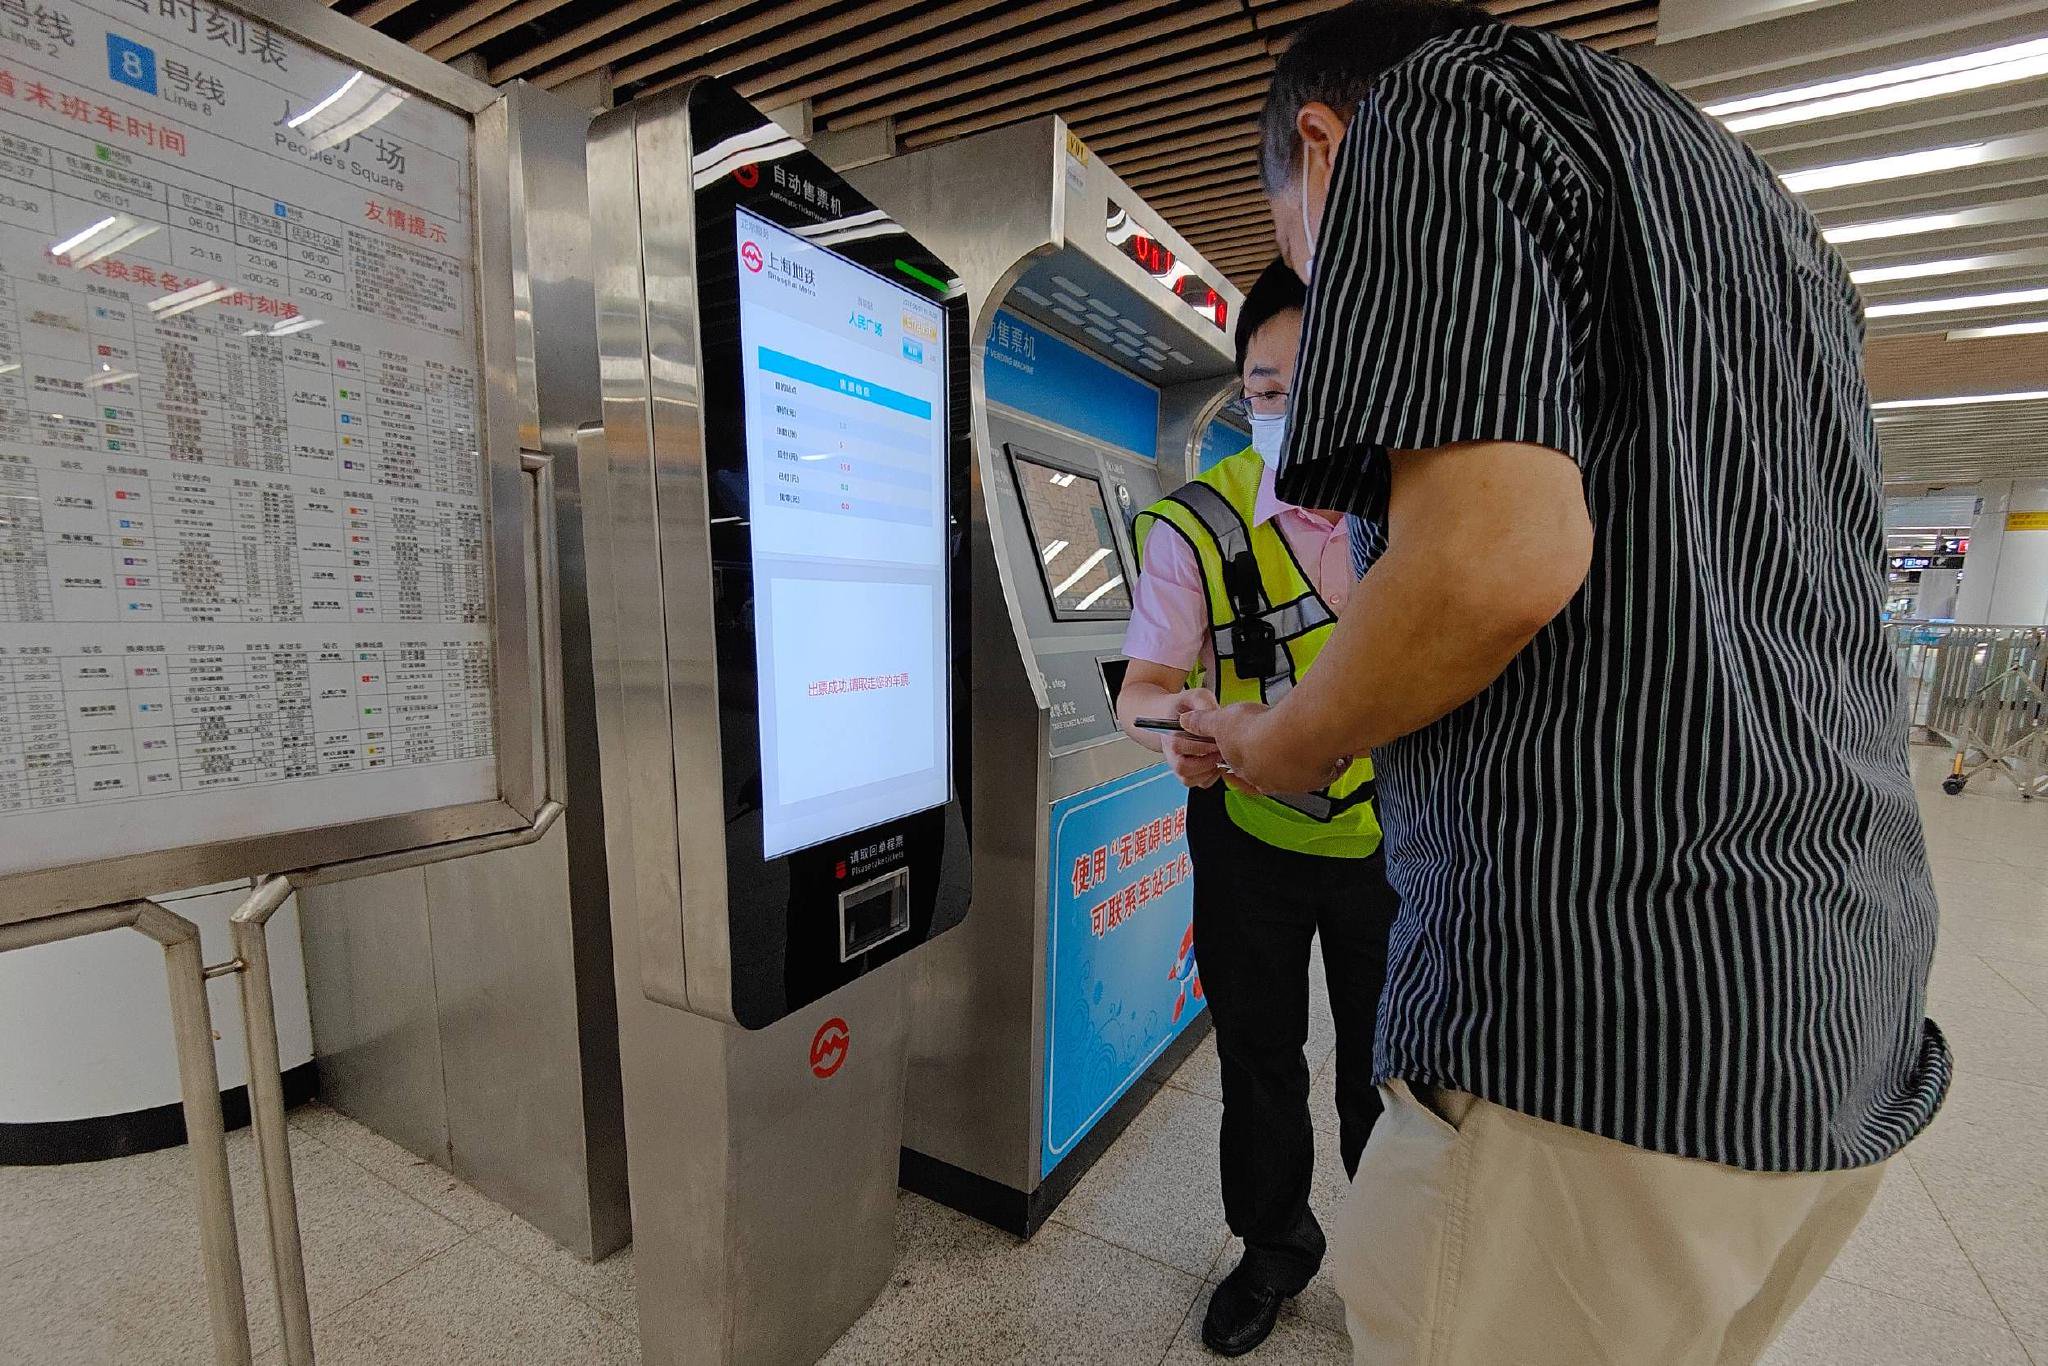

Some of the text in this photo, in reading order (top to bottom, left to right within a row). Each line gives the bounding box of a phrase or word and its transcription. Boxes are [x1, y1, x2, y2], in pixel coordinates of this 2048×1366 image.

[117, 0, 288, 72] 时刻表
[122, 50, 143, 79] 8
[161, 58, 226, 107] 号线
[164, 88, 213, 117] Line 8
[351, 160, 404, 193] Square
[774, 164, 843, 219] 自动售票机
[365, 200, 448, 244] 友情提示
[767, 251, 816, 287] 上海地铁
[848, 310, 883, 338] 人民广场
